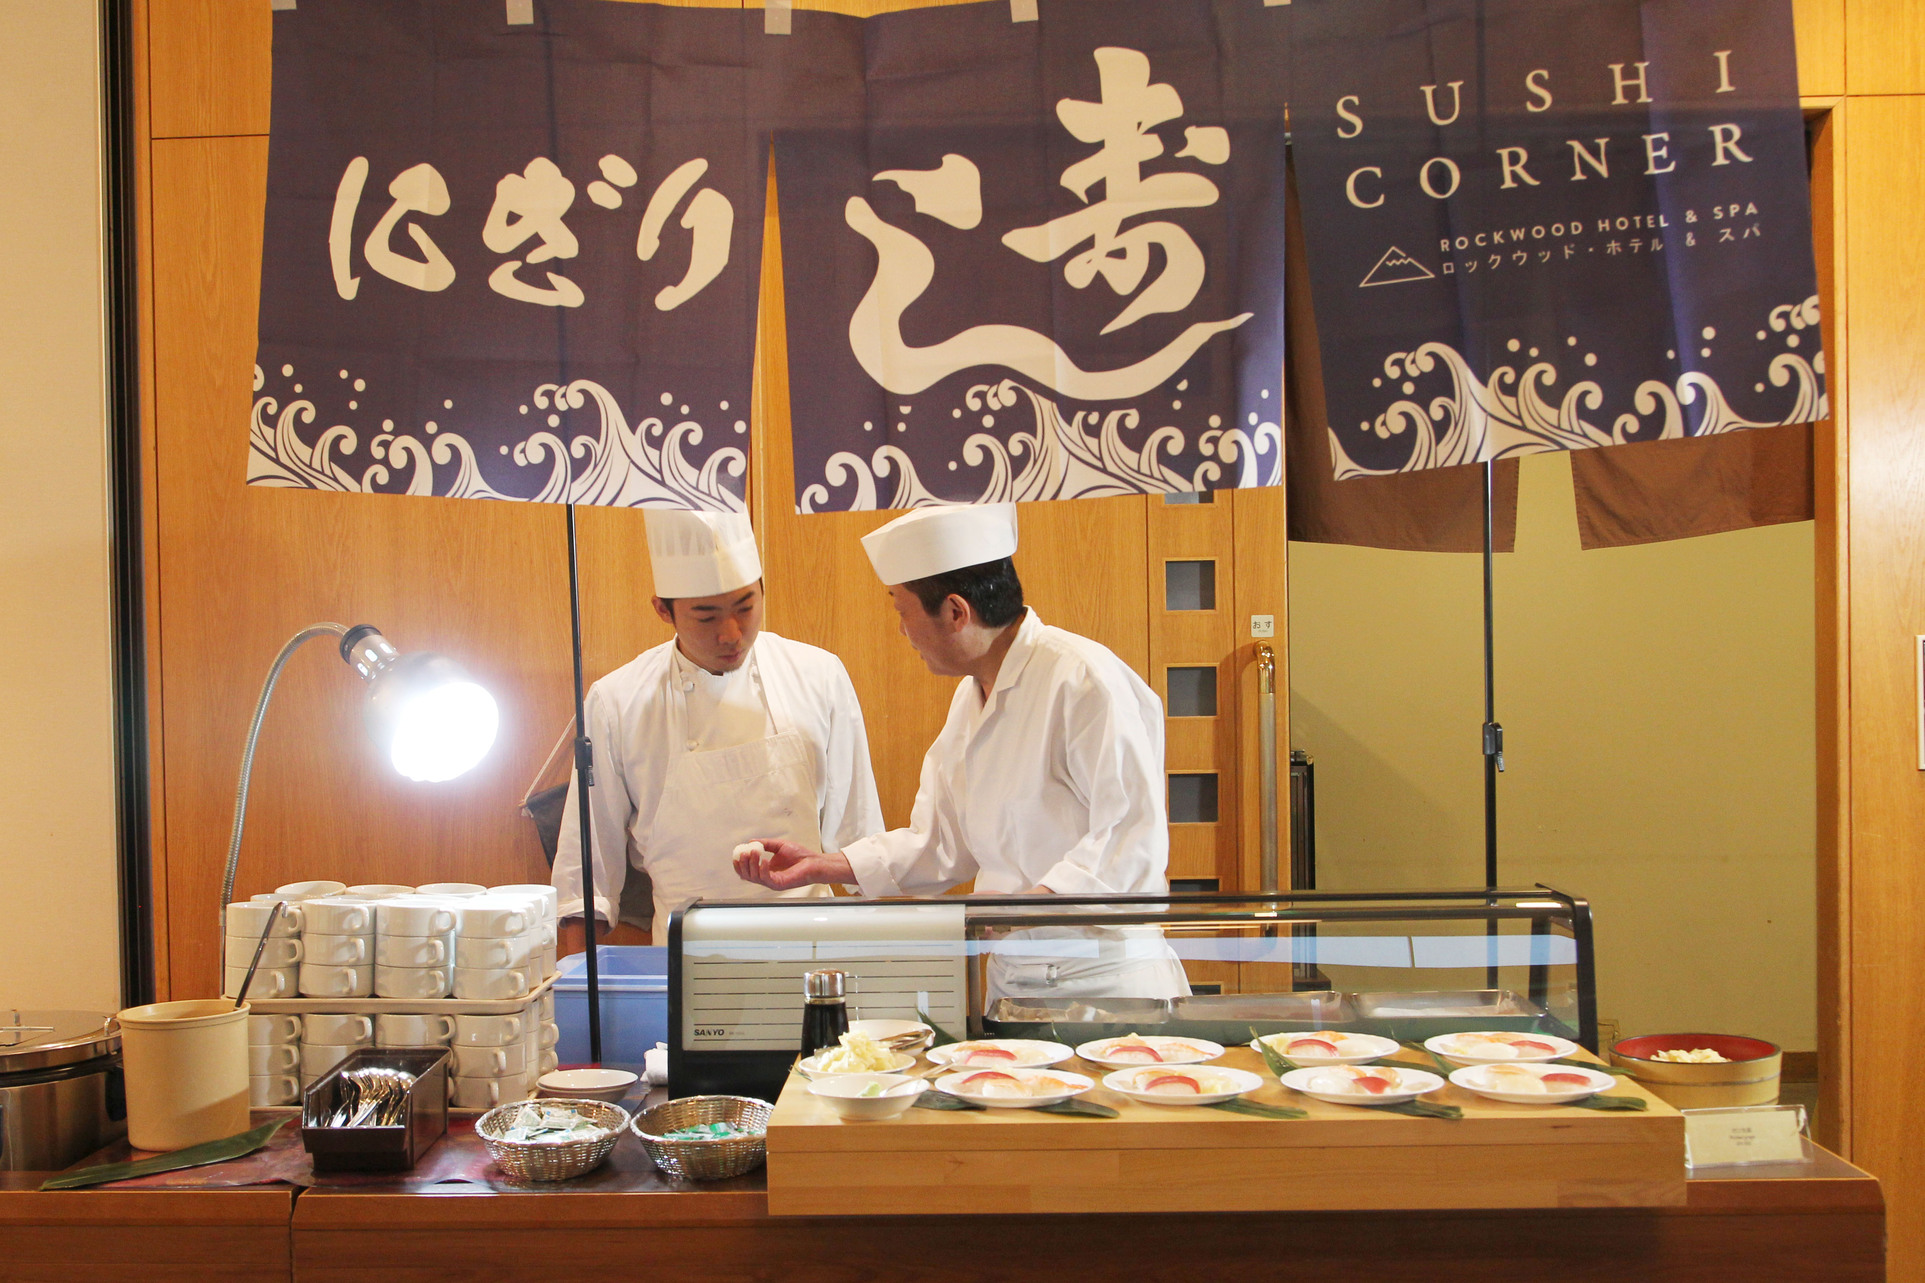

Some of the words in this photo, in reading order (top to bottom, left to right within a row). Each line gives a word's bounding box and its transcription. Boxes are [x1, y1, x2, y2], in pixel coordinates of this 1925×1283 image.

[1335, 50, 1735, 139] SUSHI
[1345, 122, 1754, 209] CORNER
[328, 153, 734, 311] にぎり
[1440, 221, 1584, 252] ROCKWOOD
[1598, 213, 1670, 233] HOTEL
[1685, 209, 1698, 224] &
[1712, 201, 1759, 221] SPA
